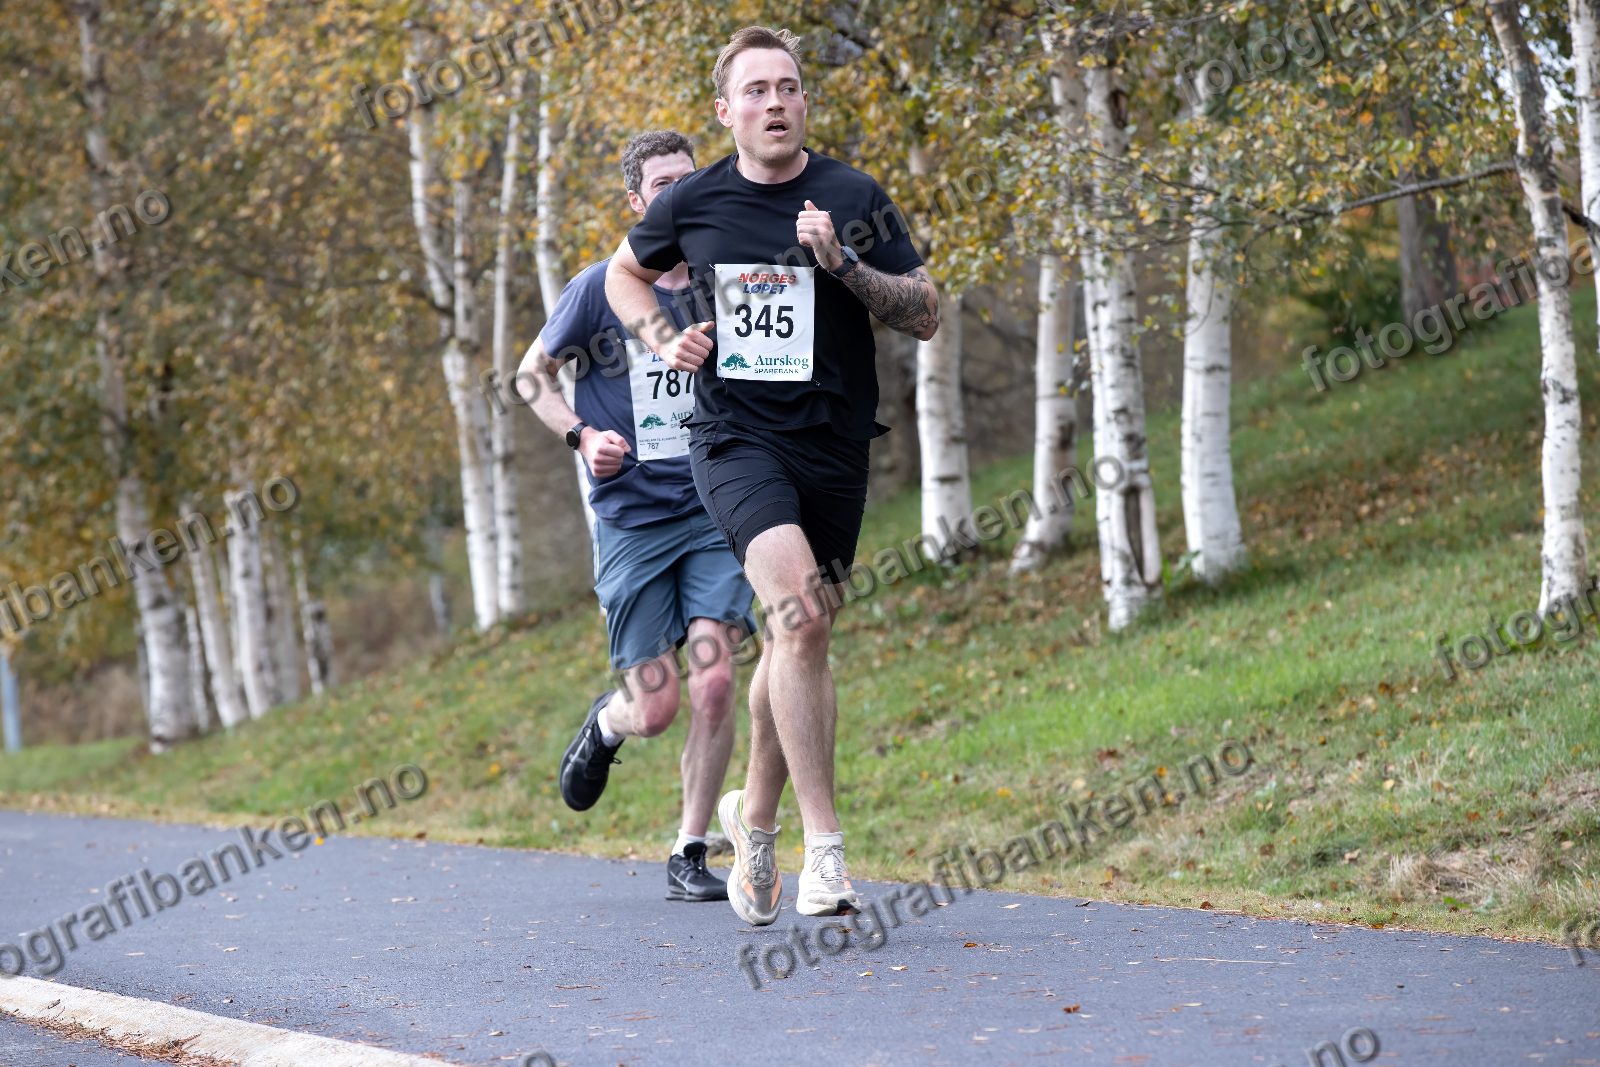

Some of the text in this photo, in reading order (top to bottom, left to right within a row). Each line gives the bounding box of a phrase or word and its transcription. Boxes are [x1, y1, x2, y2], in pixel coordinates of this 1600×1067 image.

[738, 273, 797, 285] NORGES
[743, 284, 788, 295] LØPET
[734, 303, 794, 339] 345
[754, 354, 809, 370] Aurskog
[646, 369, 693, 400] 787
